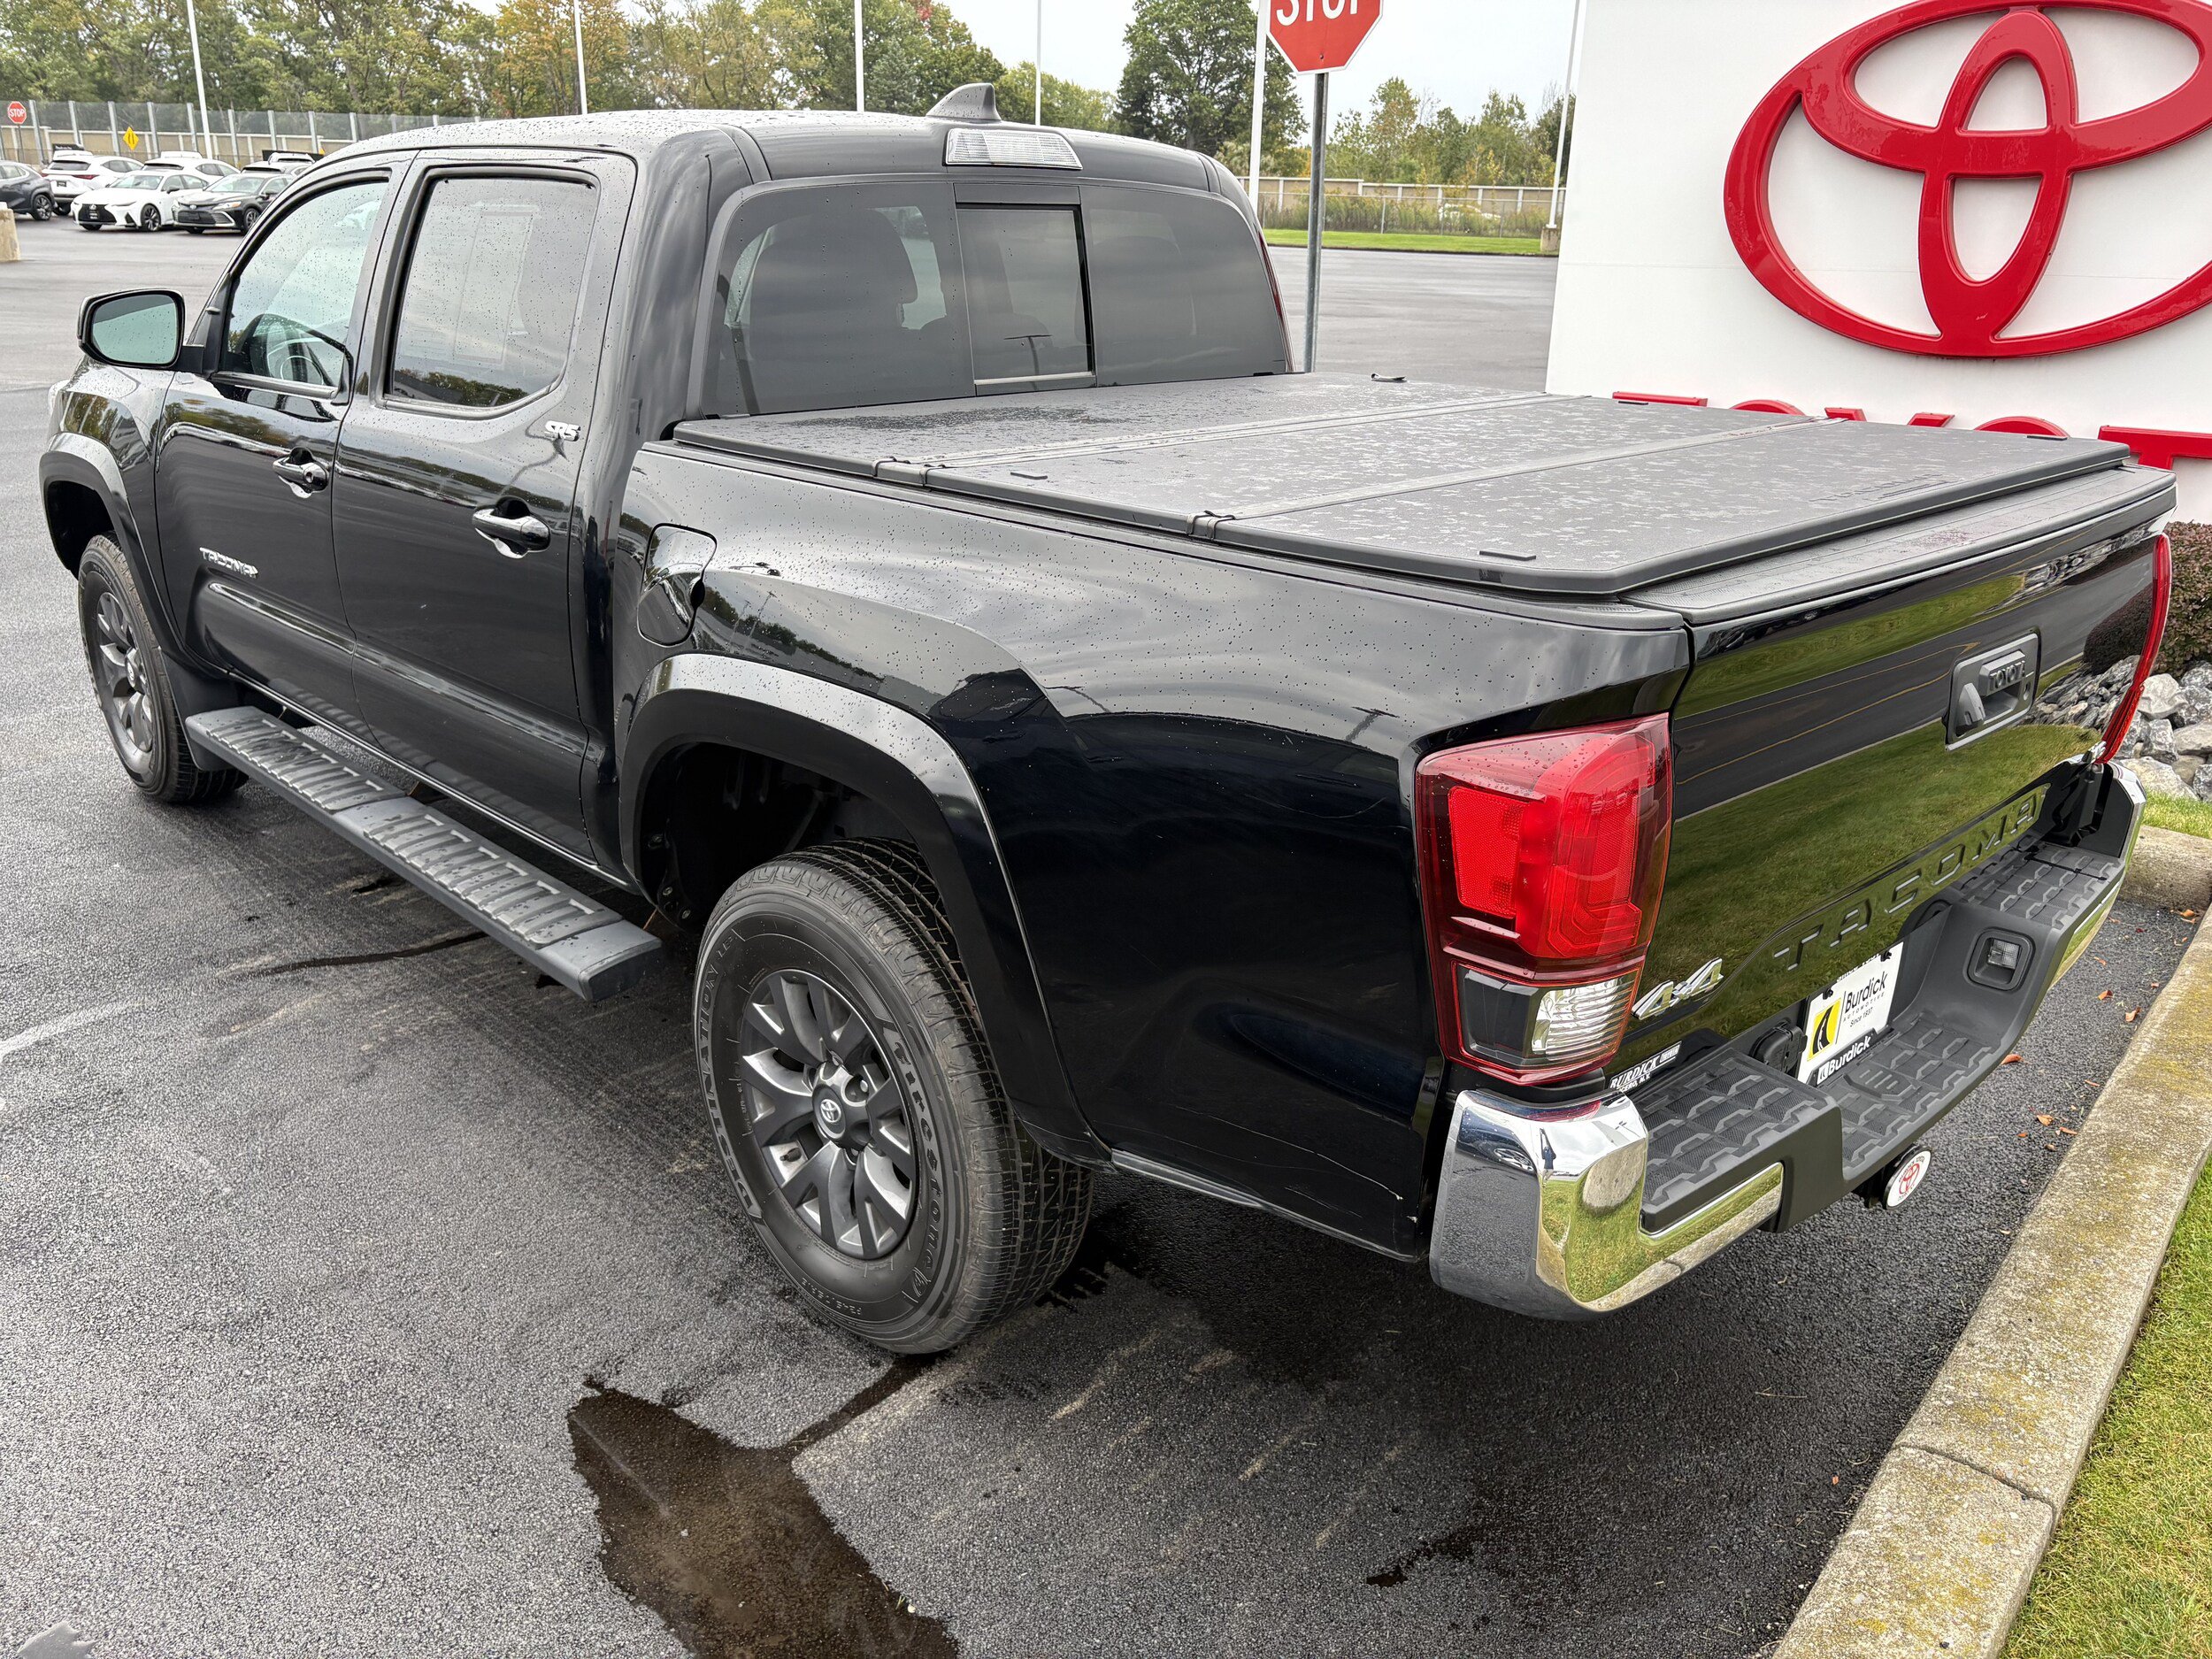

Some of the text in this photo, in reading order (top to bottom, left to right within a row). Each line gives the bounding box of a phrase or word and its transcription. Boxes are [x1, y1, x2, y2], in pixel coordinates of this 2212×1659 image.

[9, 108, 26, 117] STOP
[544, 420, 580, 442] SR5
[199, 547, 258, 579] TACOMA
[1772, 794, 2037, 971] TACOMA
[1843, 992, 1885, 1023] AUTOMOTIVE
[1845, 971, 1888, 1014] Burdick
[1850, 1015, 1863, 1027] Since
[1609, 1055, 1661, 1089] BURDICK
[1828, 1035, 1871, 1077] Burdick
